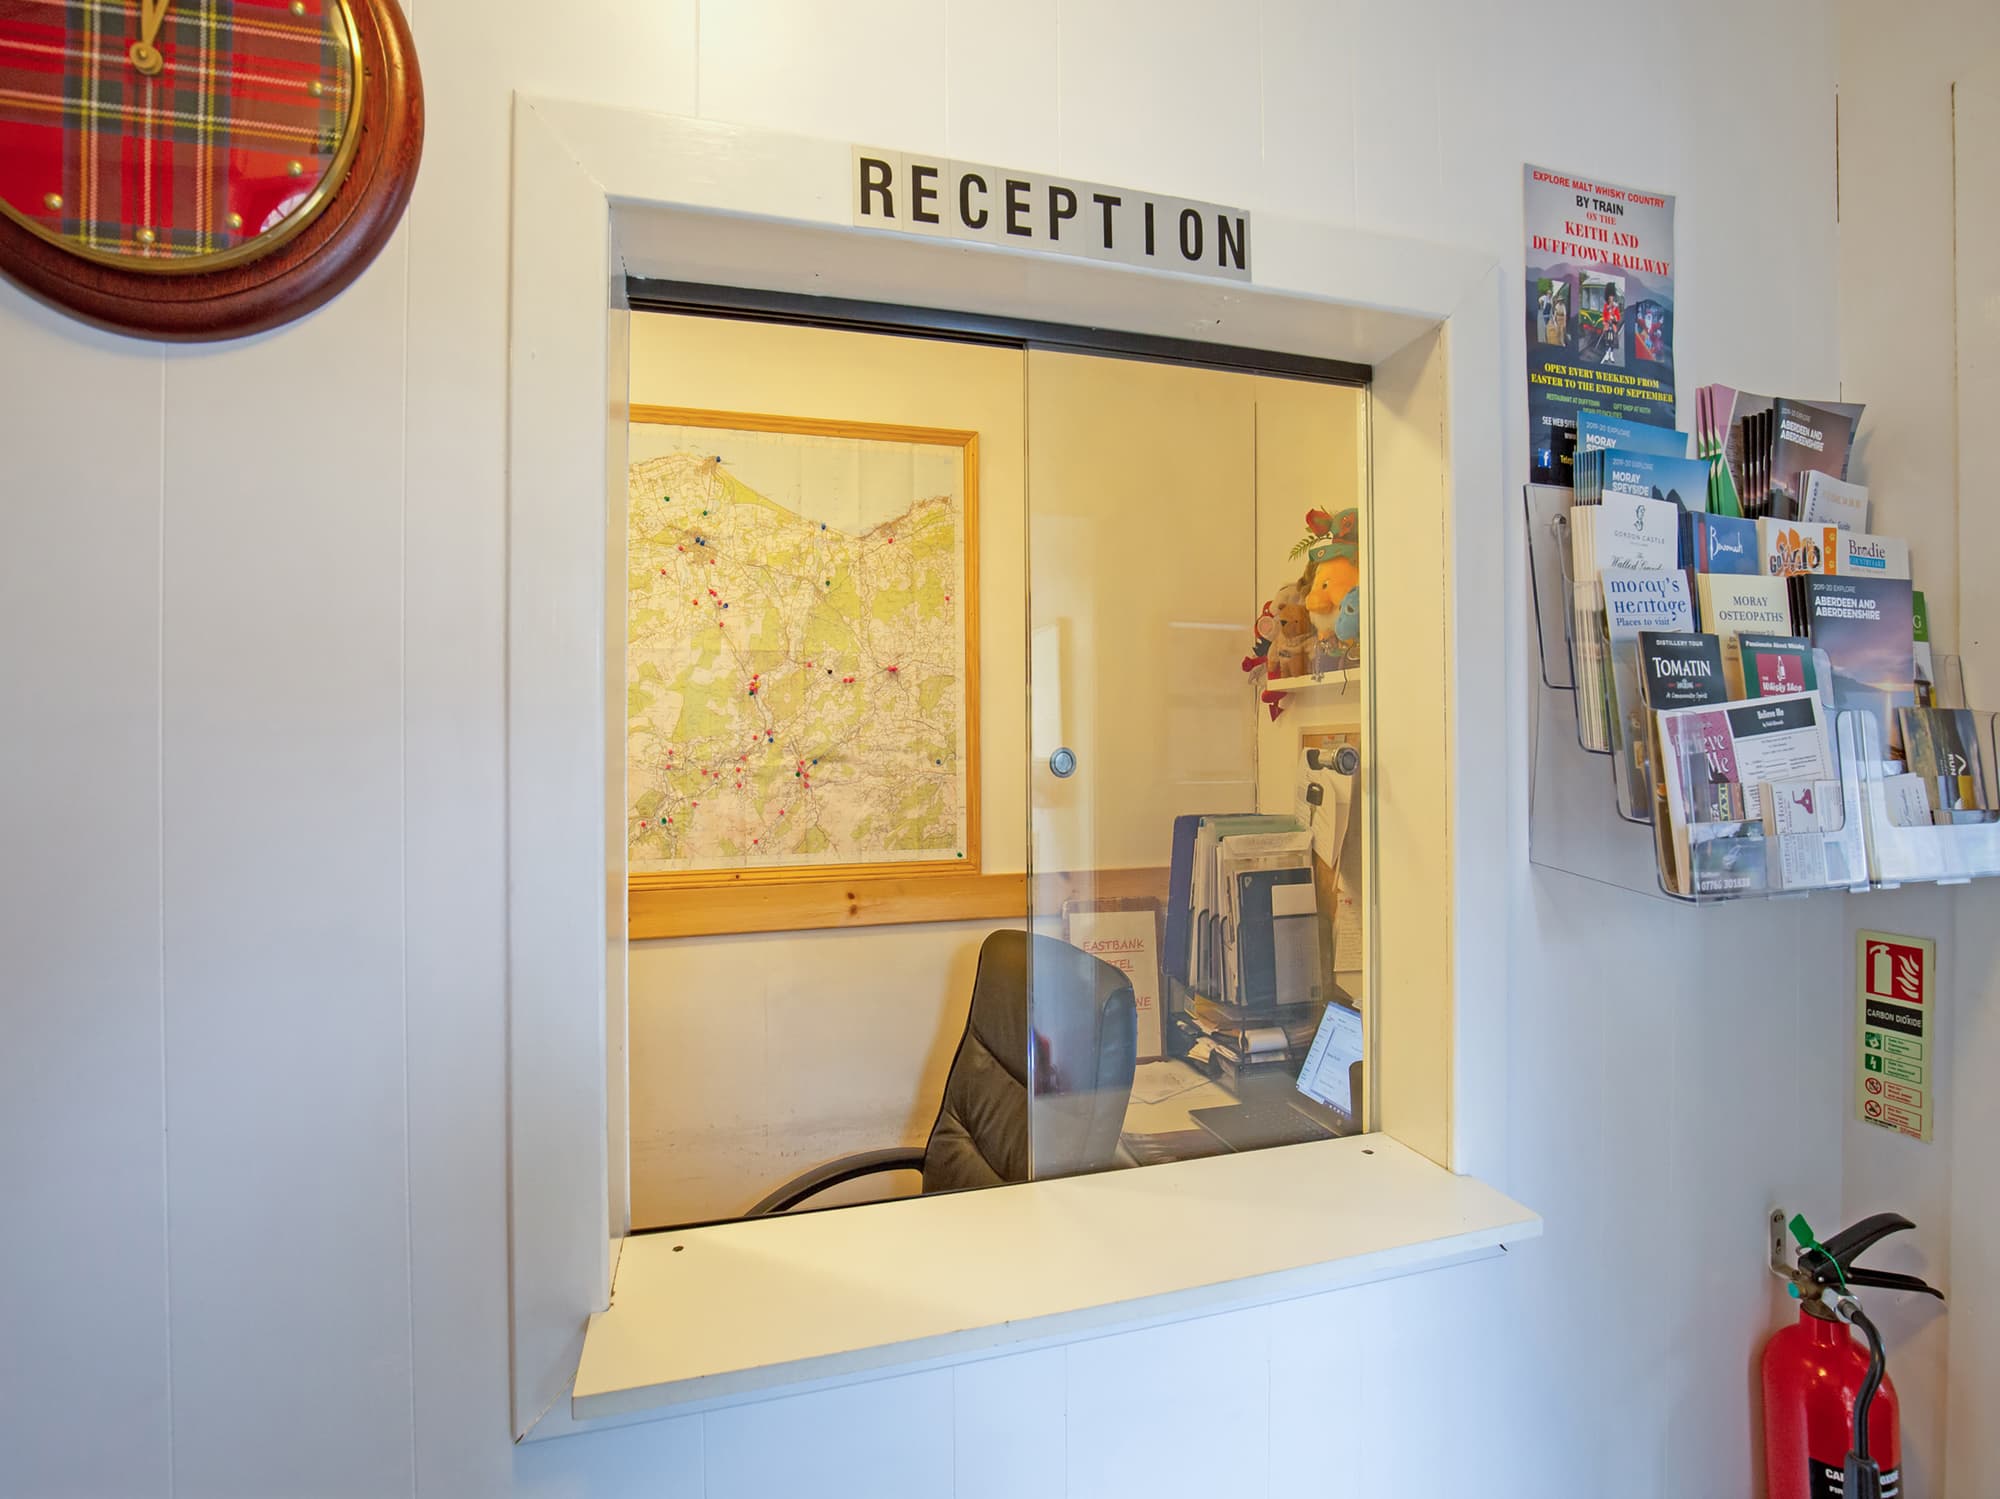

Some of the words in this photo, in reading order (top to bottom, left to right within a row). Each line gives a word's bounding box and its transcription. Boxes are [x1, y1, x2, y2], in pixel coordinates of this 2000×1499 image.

[1533, 170, 1570, 188] EXPLORE
[1572, 180, 1593, 192] MALT
[1595, 185, 1626, 200] WHISKY
[1627, 193, 1665, 209] COUNTRY
[860, 157, 1246, 270] RECEPTION
[1576, 195, 1590, 208] BY
[1592, 199, 1624, 216] TRAIN
[1586, 211, 1597, 221] ON
[1599, 214, 1616, 226] THE
[1565, 221, 1608, 243] KEITH
[1612, 231, 1639, 249] AND
[1532, 235, 1608, 265] DUFFTOWN
[1612, 252, 1670, 276] RAILWAY
[1544, 363, 1567, 375] OPEN
[1568, 366, 1594, 379] EVERY
[1595, 371, 1636, 385] WEEKEND
[1637, 376, 1659, 389] FROM
[1531, 373, 1563, 387] EASTER
[1564, 378, 1576, 389] TO
[1578, 380, 1594, 392] THE
[1596, 383, 1612, 394] END
[1613, 386, 1625, 396] OF
[1626, 389, 1673, 403] SEPTEMBER
[1542, 415, 1552, 426] SEE
[1552, 417, 1564, 427] WEB
[1780, 419, 1810, 437] ABERDEEN
[1810, 429, 1823, 441] AND
[1586, 433, 1617, 449] MORAY
[1612, 470, 1640, 484] MORAY
[1612, 481, 1649, 497] SPEYSIDE
[1848, 539, 1886, 559] Brodie
[1611, 577, 1680, 598] moray's
[1732, 596, 1768, 607] MORAY
[1814, 596, 1857, 608] ABERDEEN
[1858, 599, 1876, 610] AND
[1616, 617, 1641, 627] Places
[1643, 618, 1652, 626] to
[1654, 618, 1670, 626] visit
[1719, 610, 1784, 622] OSTEOPATHS
[1815, 606, 1880, 620] ABERDEENSHIRE
[1652, 656, 1711, 678] TOMATIN
[1083, 938, 1144, 950] EASTBANK
[1867, 1009, 1895, 1021] CARBON
[1895, 1015, 1921, 1028] DIOXIDE
